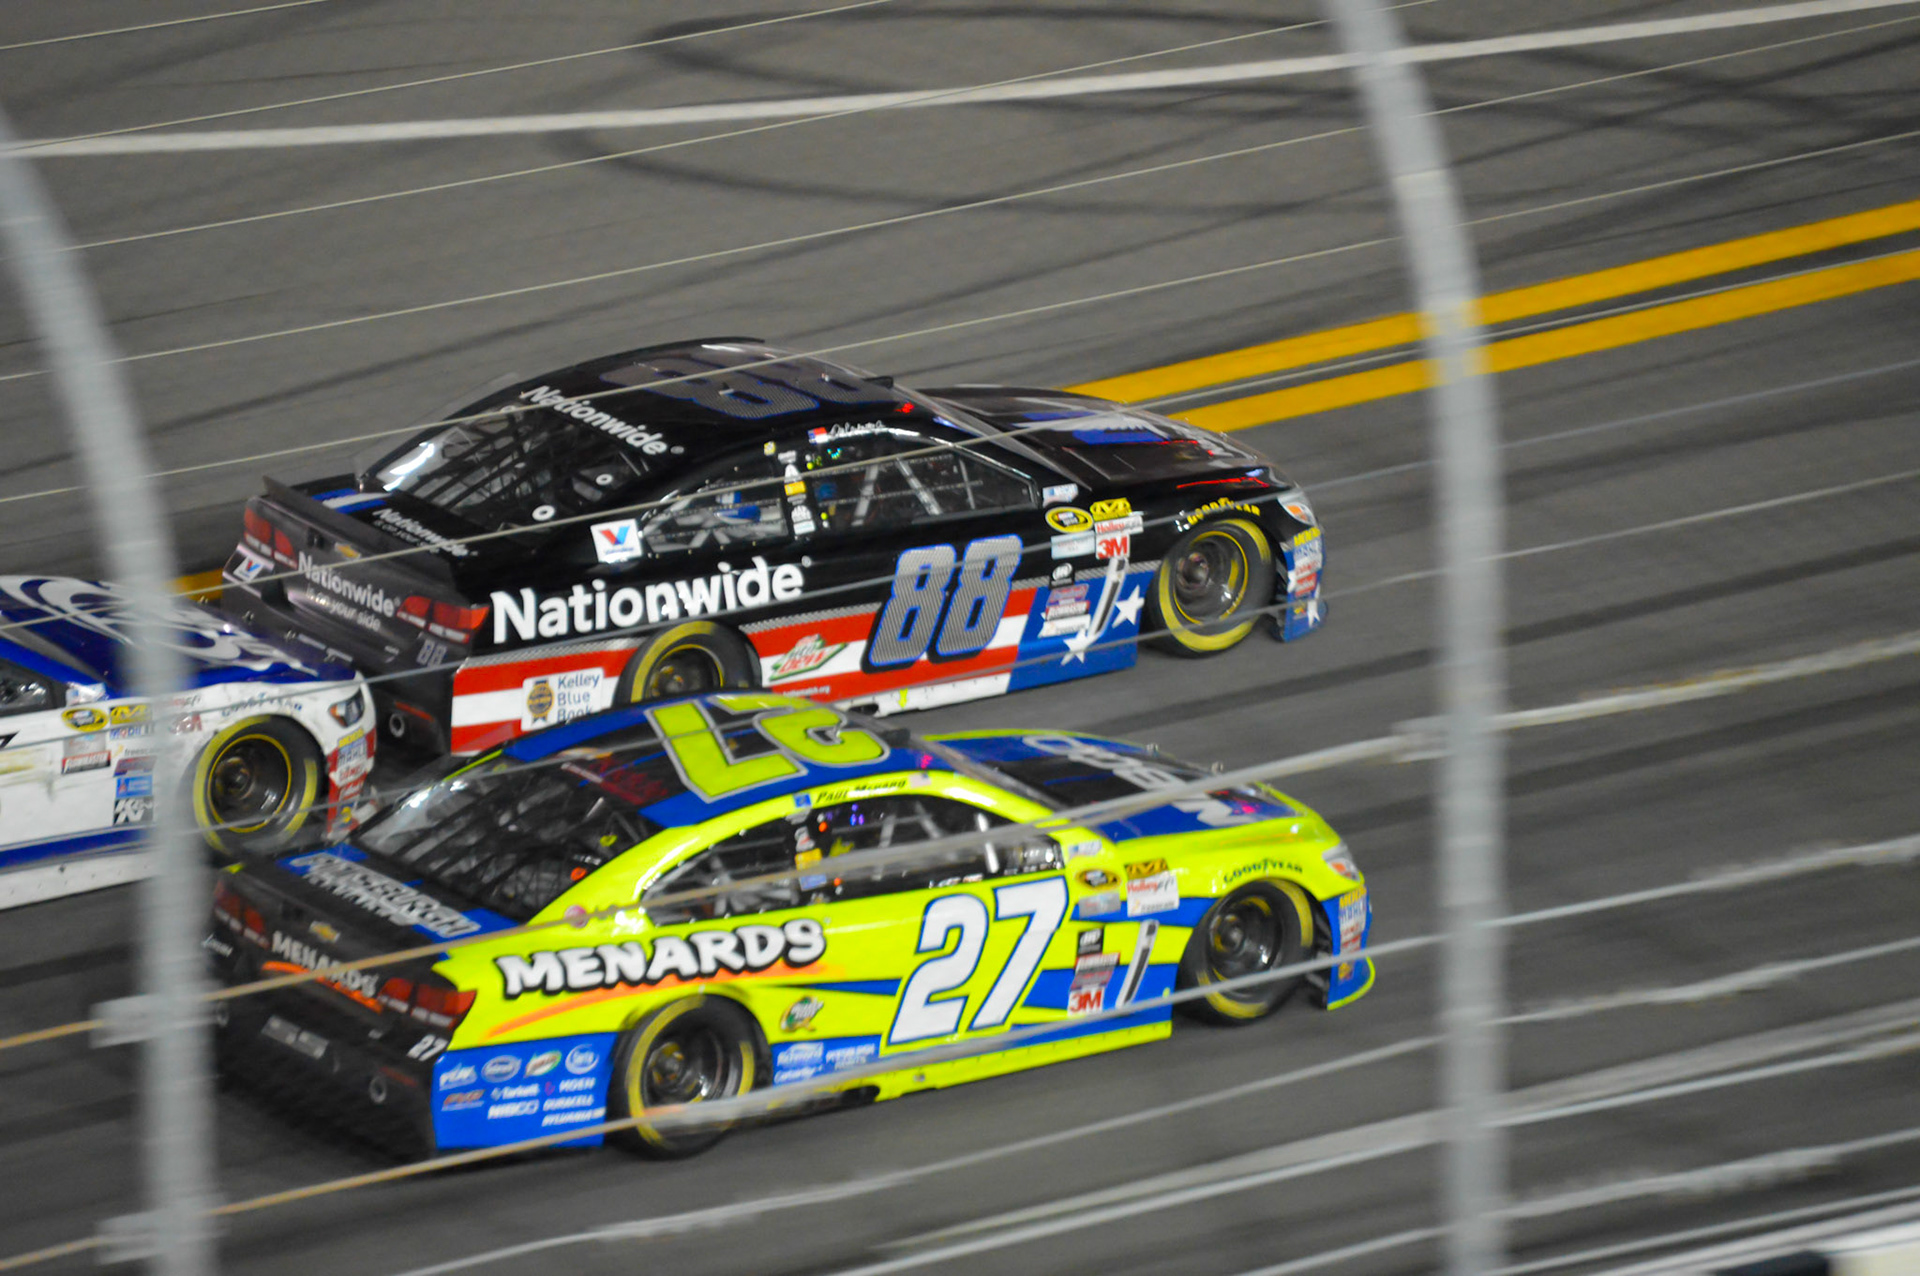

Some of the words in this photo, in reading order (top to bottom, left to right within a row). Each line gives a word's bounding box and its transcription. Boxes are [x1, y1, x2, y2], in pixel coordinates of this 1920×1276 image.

[519, 385, 668, 455] Nationwide
[1097, 536, 1128, 560] 3M
[299, 550, 396, 618] Nationwide
[491, 556, 804, 644] Nationwide
[868, 535, 1023, 668] 88
[330, 599, 356, 622] your
[356, 609, 382, 632] side
[557, 673, 600, 690] Kelley
[557, 691, 591, 706] Blue
[1223, 858, 1303, 884] GOODYEAR
[272, 929, 379, 998] MENARDS
[494, 917, 828, 1000] MENARDS
[889, 876, 1068, 1045] 27
[1070, 990, 1102, 1013] 3M
[406, 1034, 449, 1062] 27
